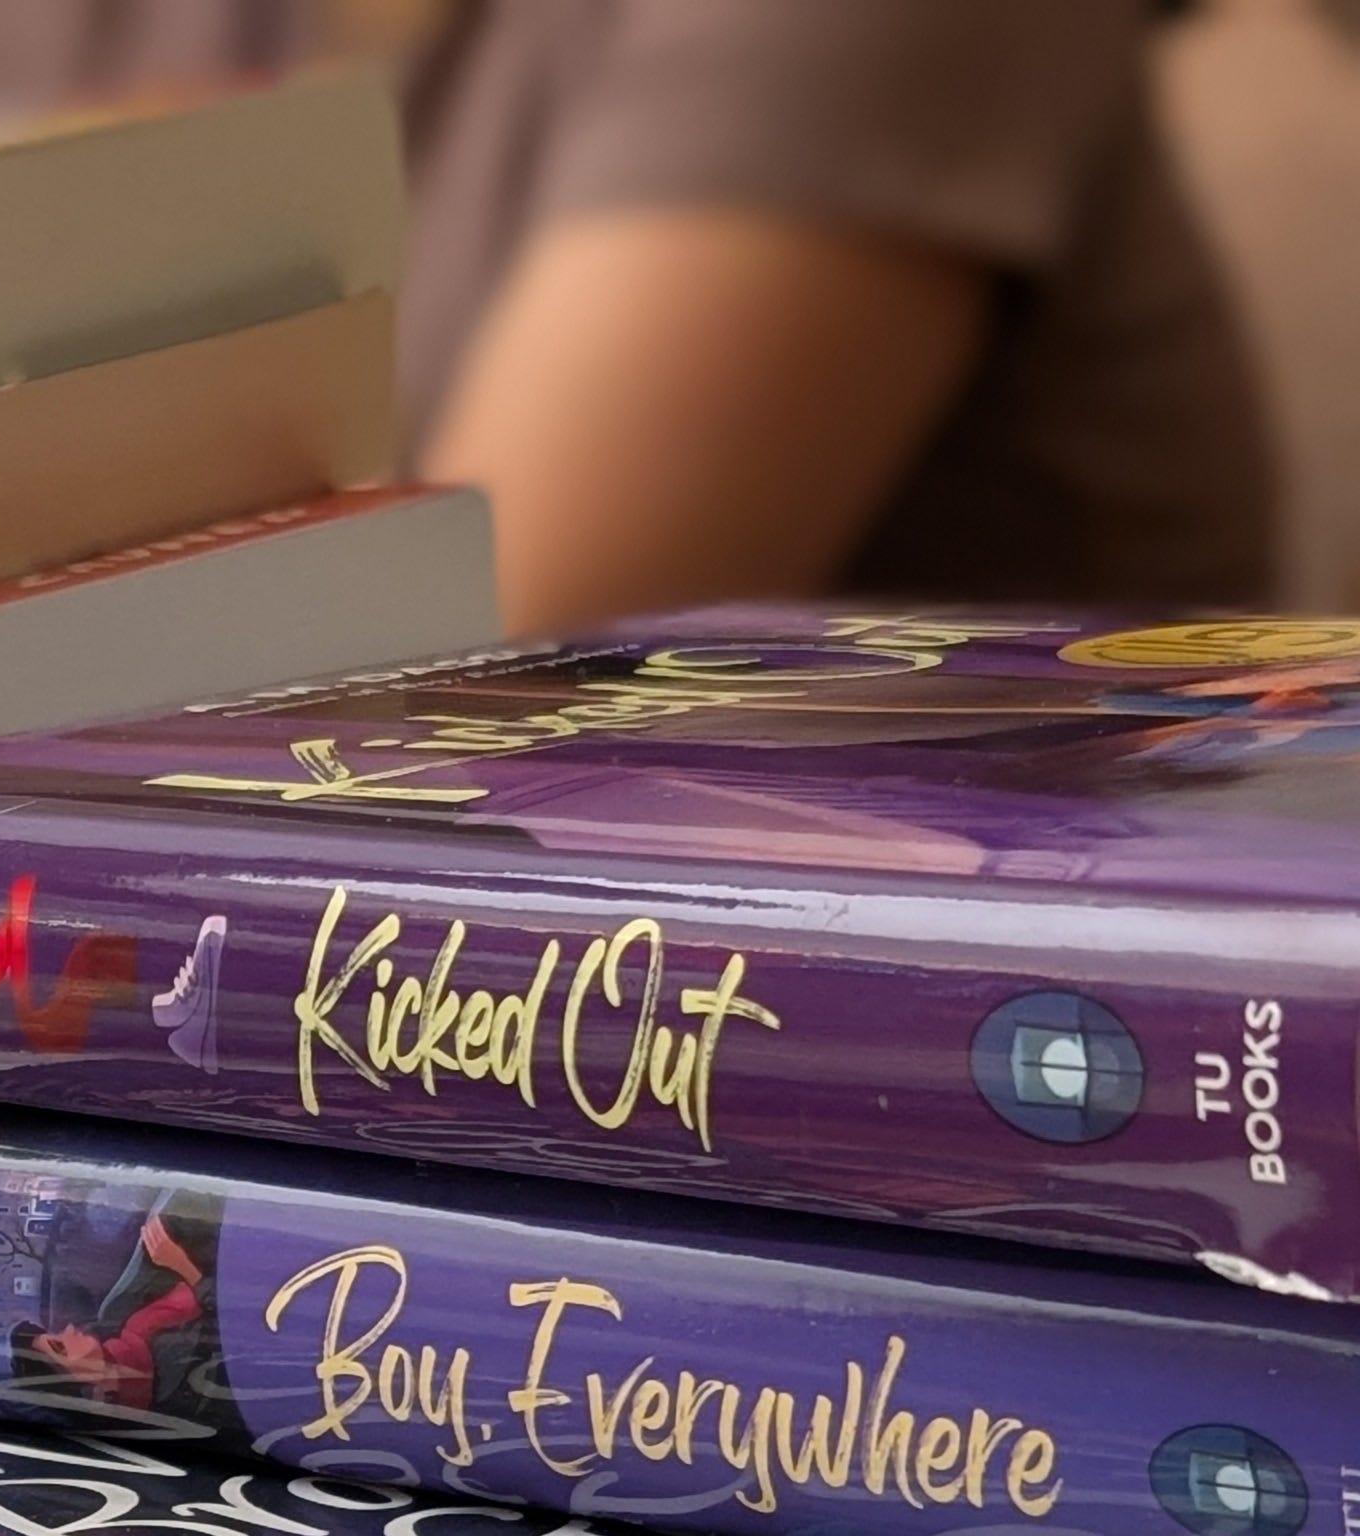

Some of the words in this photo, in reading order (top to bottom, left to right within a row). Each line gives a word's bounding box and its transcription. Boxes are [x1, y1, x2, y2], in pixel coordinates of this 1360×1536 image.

[294, 883, 562, 1116] Kicked
[563, 916, 781, 1153] Out
[1194, 1051, 1231, 1123] TU
[1242, 998, 1287, 1185] BOOKS
[265, 1244, 493, 1468] Boy,
[508, 1276, 1064, 1518] Everywhere
